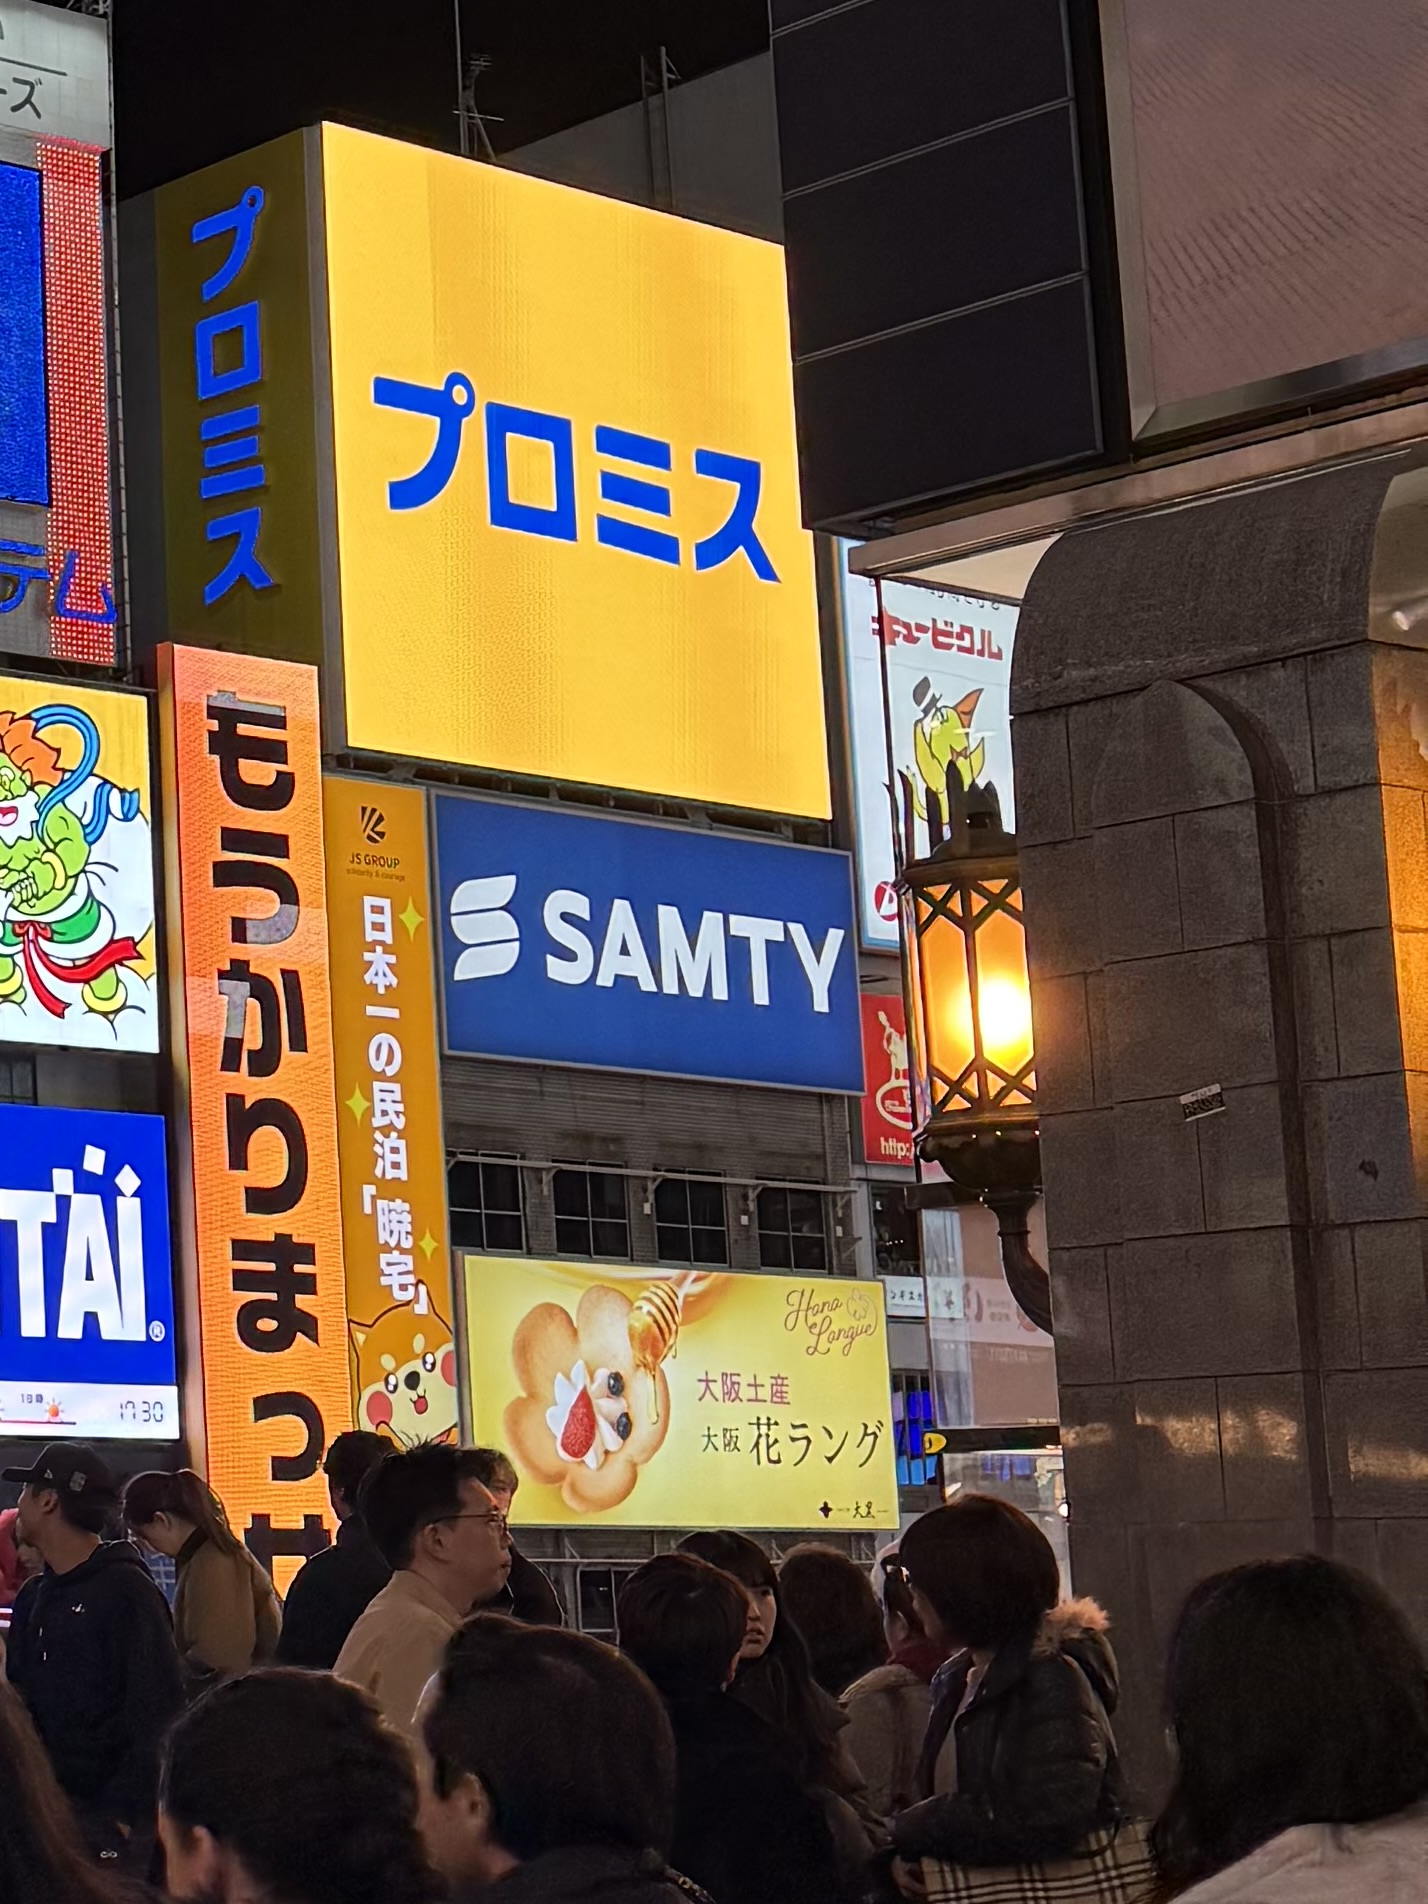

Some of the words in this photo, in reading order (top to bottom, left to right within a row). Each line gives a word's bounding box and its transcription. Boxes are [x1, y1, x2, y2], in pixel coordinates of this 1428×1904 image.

[190, 184, 279, 606] プロミス
[372, 371, 782, 584] プロミス
[349, 852, 362, 865] JS
[364, 853, 401, 870] GROUP
[542, 888, 845, 1014] SAMTY
[696, 1371, 792, 1407] 大阪土産
